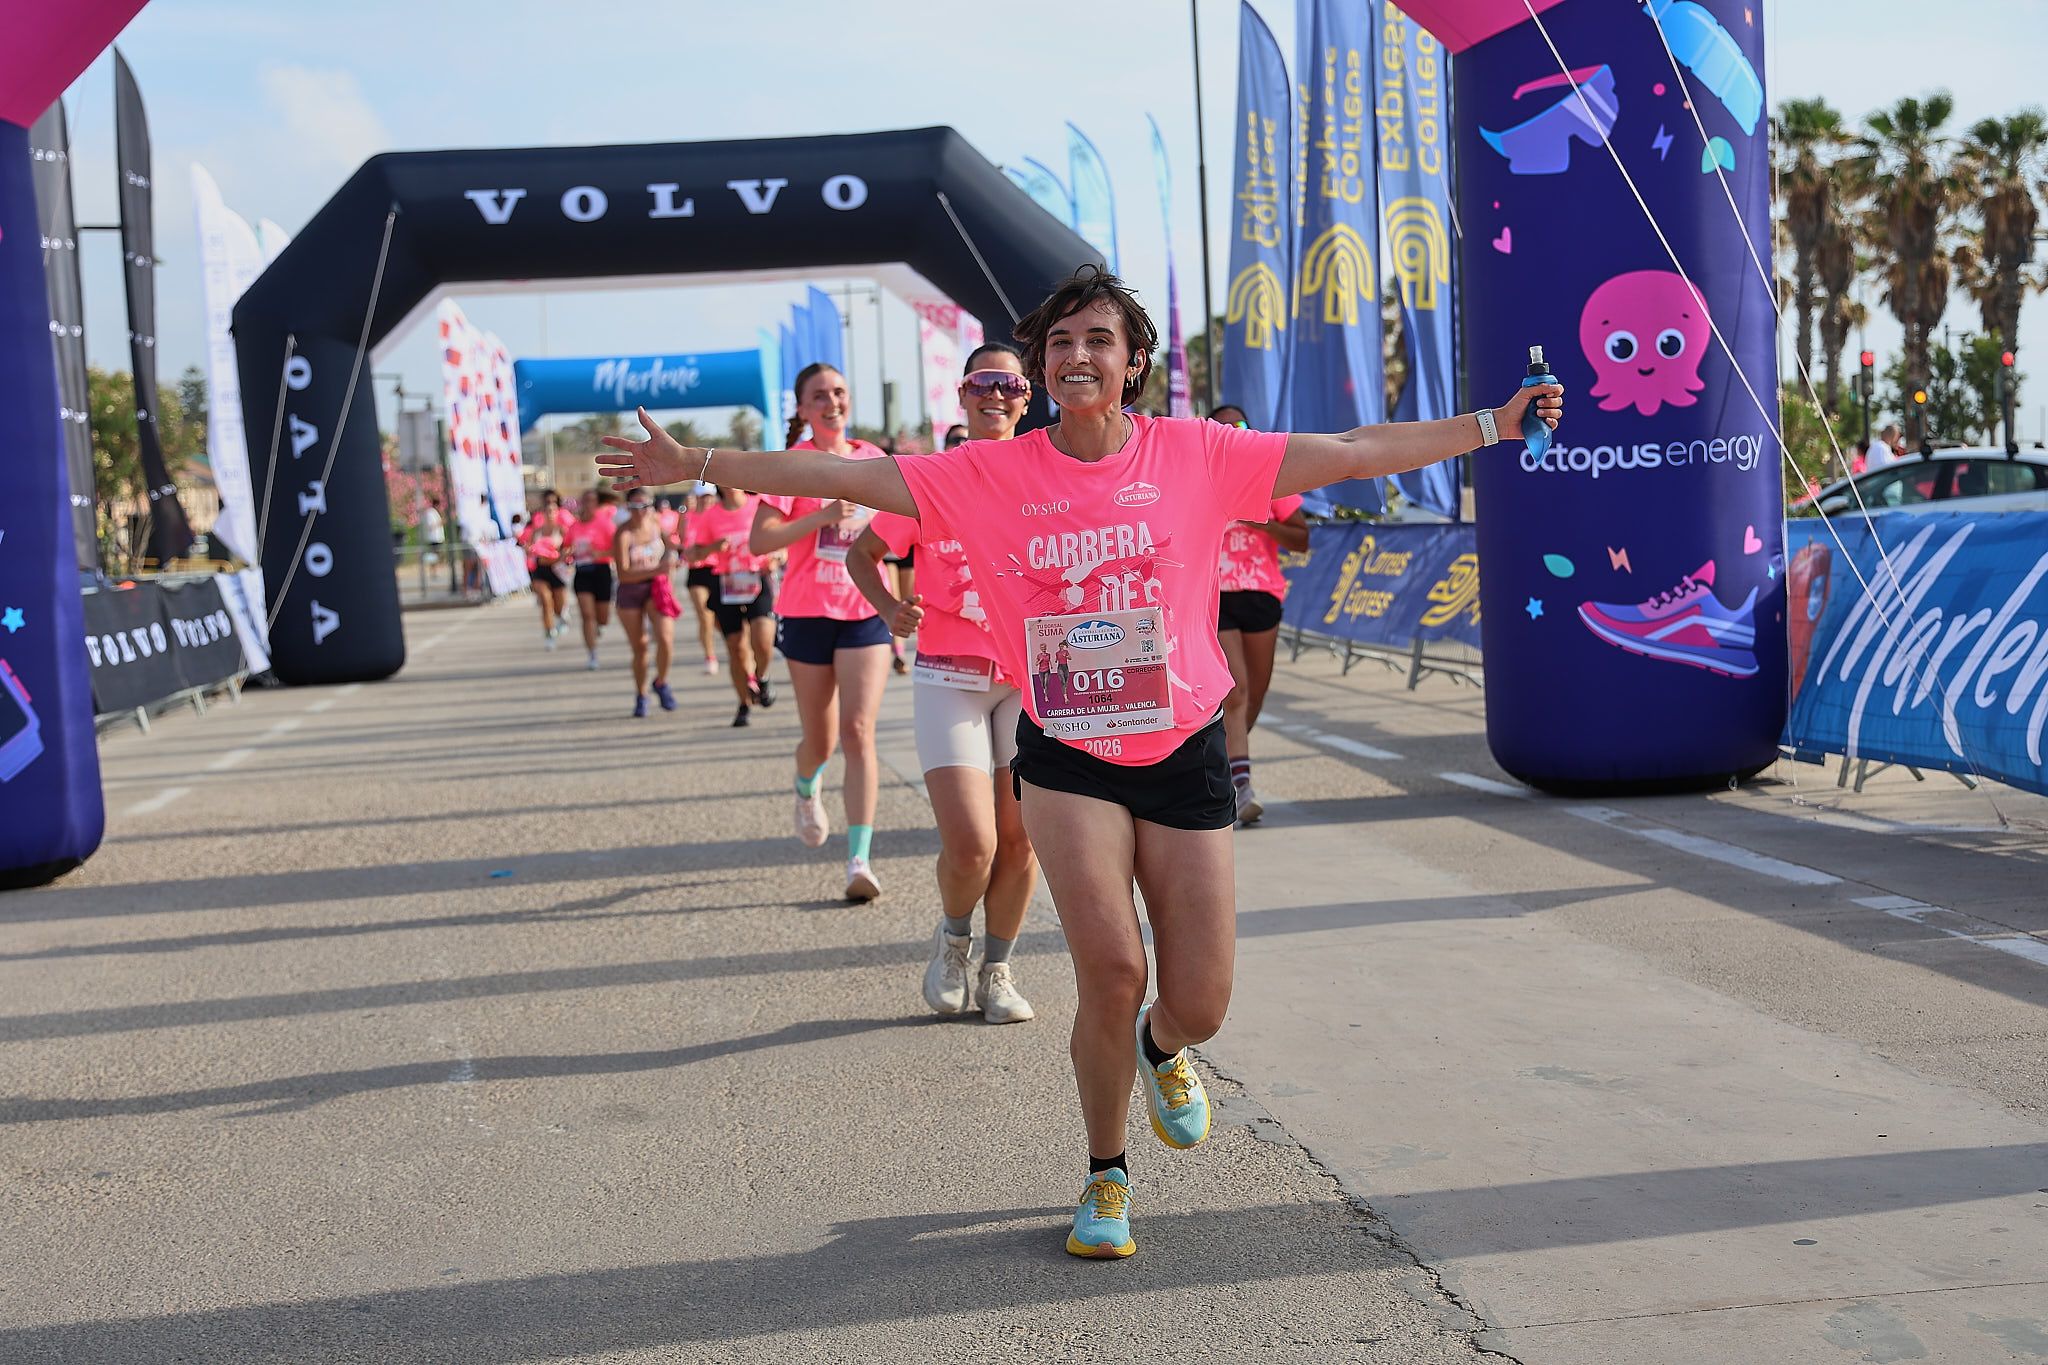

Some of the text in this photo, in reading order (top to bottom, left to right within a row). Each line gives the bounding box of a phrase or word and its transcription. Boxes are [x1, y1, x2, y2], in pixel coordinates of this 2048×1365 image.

[463, 174, 869, 225] VOLVO
[1519, 433, 1764, 479] octopus energy
[286, 355, 341, 645] VOLVO
[1021, 499, 1070, 517] OYSHO
[1038, 628, 1064, 637] SUMA
[1070, 631, 1121, 644] ASTURIANA
[84, 621, 167, 667] VOLVO
[1073, 668, 1125, 692] 016
[1089, 694, 1113, 704] 1064
[1047, 708, 1075, 717] CARRERA
[1076, 707, 1086, 715] DE
[1087, 706, 1096, 714] LA
[1097, 704, 1120, 713] MUJER
[1125, 700, 1157, 711] VALENCIA
[1053, 716, 1159, 733] OYSHO Santander
[1084, 738, 1122, 757] 2026
